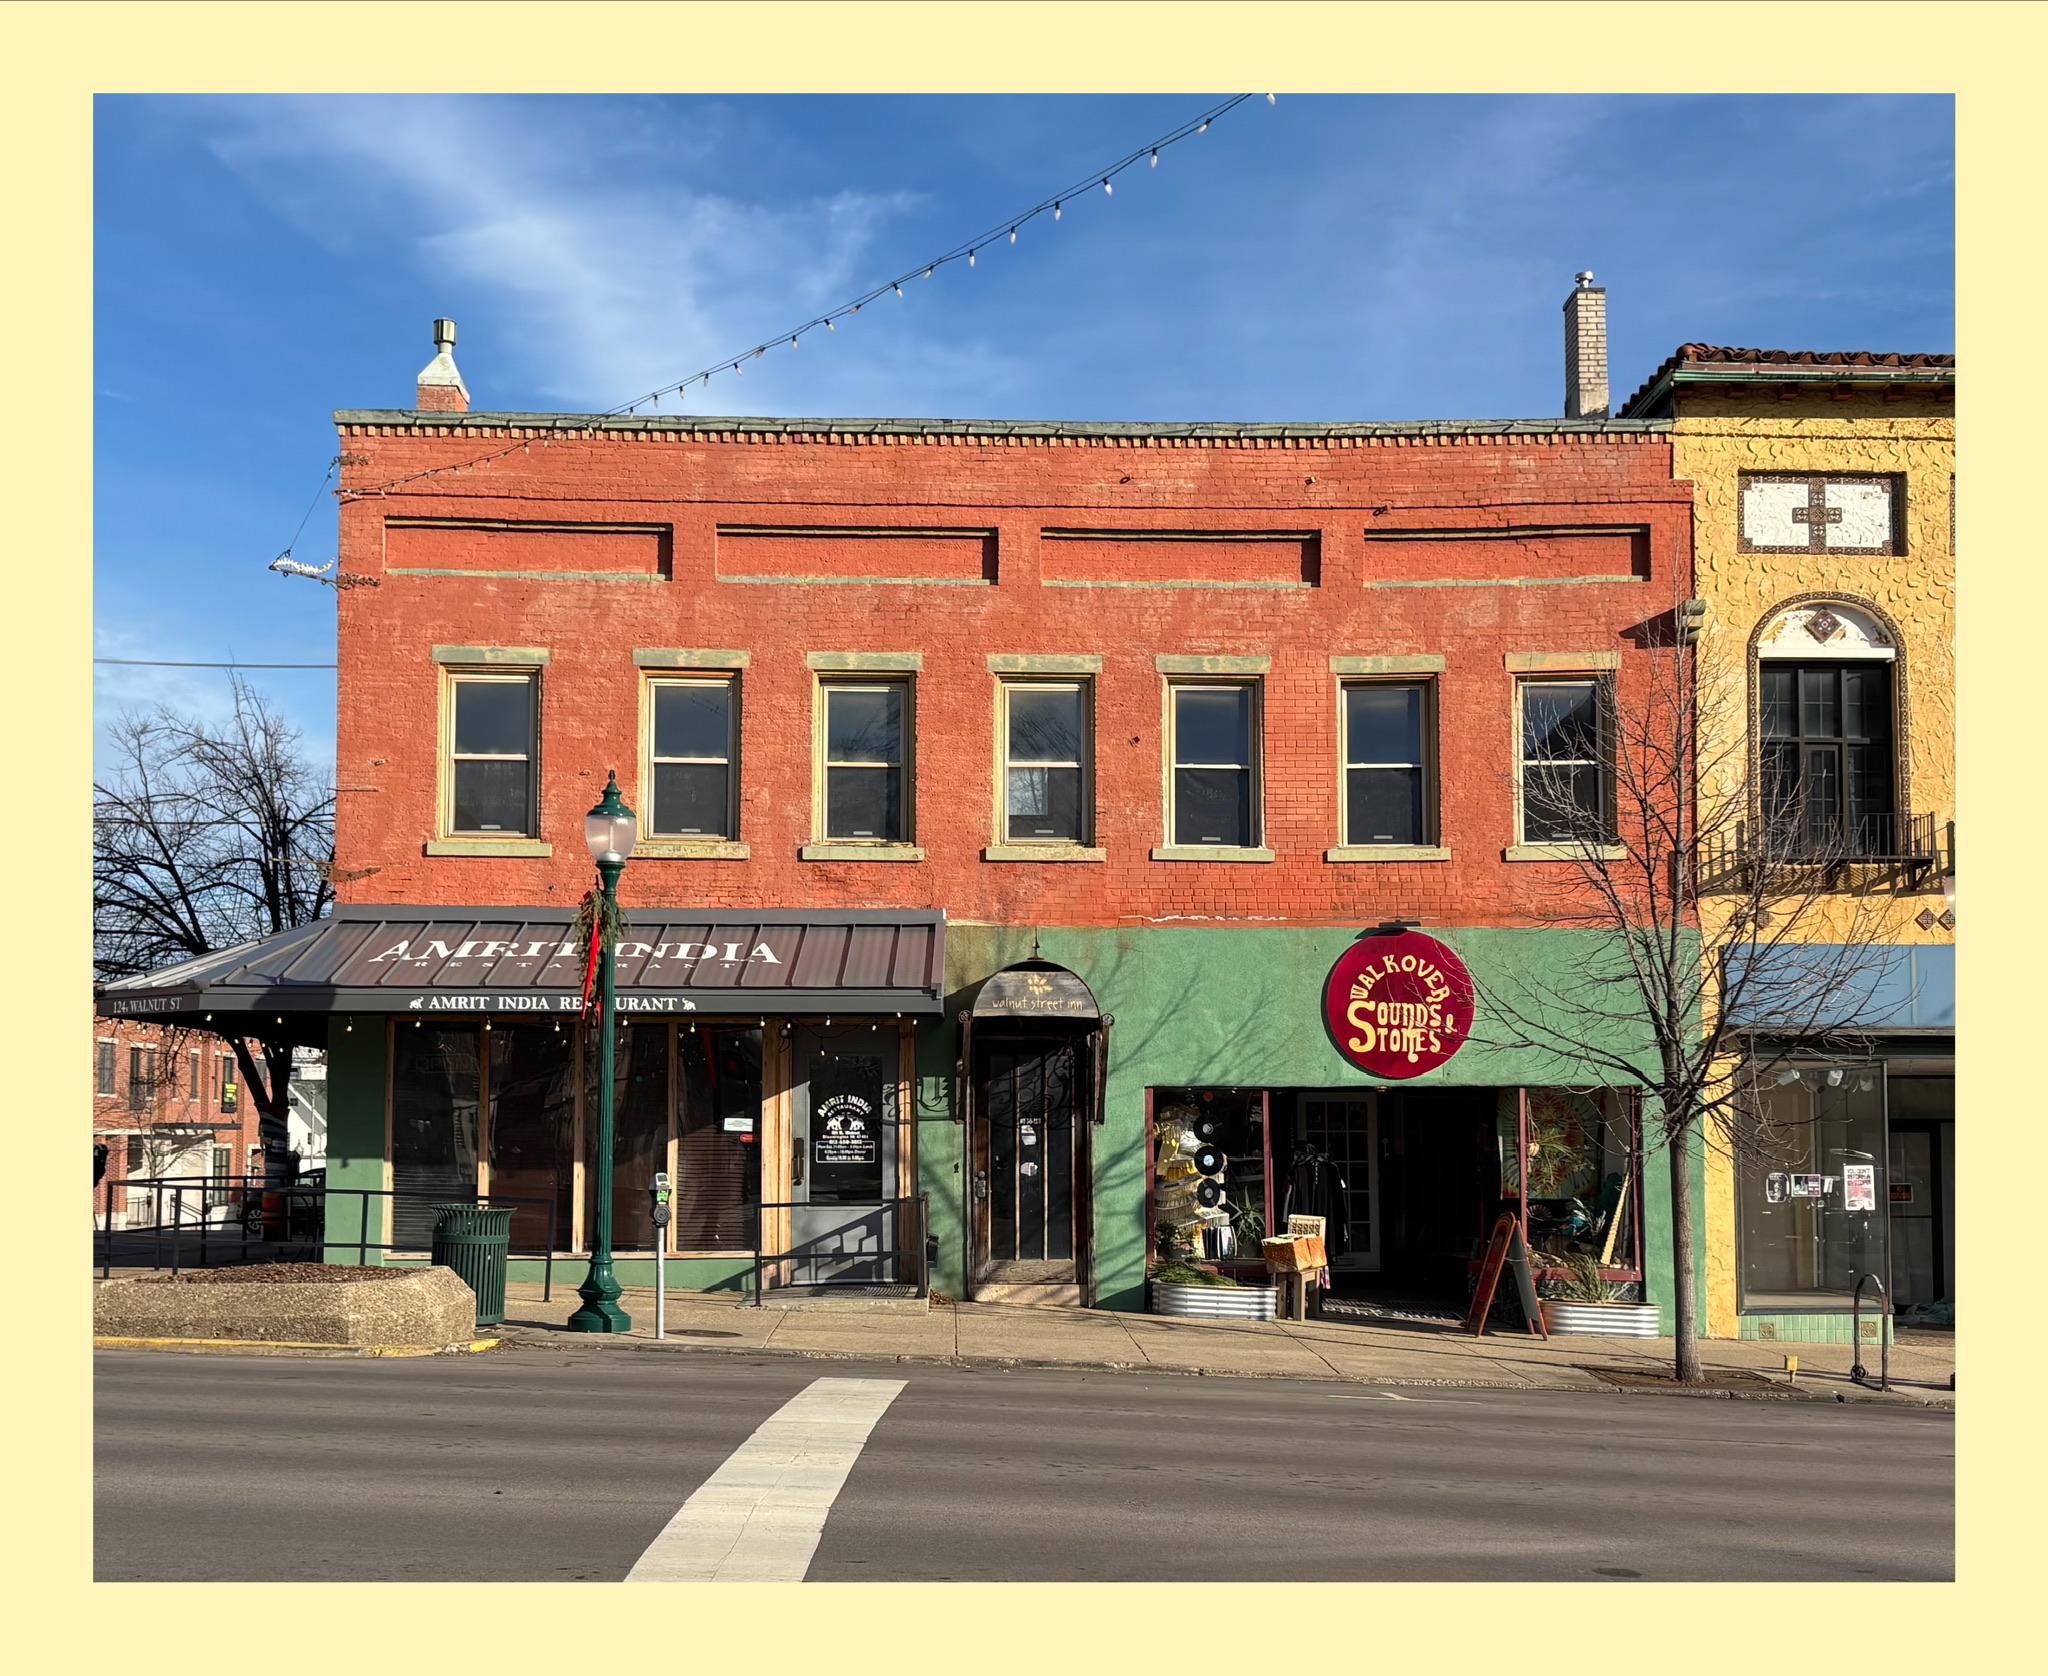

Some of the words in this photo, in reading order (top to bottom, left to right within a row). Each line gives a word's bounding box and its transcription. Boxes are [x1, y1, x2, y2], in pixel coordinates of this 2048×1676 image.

[368, 940, 580, 963] AMRIT
[612, 942, 783, 965] INDIA
[414, 961, 736, 969] RESTARANT
[1350, 954, 1450, 1003] WALKOVER
[129, 998, 167, 1012] WALNUT
[169, 997, 182, 1010] ST
[428, 996, 490, 1010] AMRIT
[498, 996, 550, 1010] INDIA
[559, 997, 678, 1011] REURANT
[992, 996, 1028, 1009] walnut
[1031, 996, 1064, 1010] street
[1067, 999, 1083, 1010] inn
[817, 1094, 845, 1118] AMRIT
[847, 1094, 873, 1114] INDIA
[827, 1104, 865, 1118] RESTAURANT
